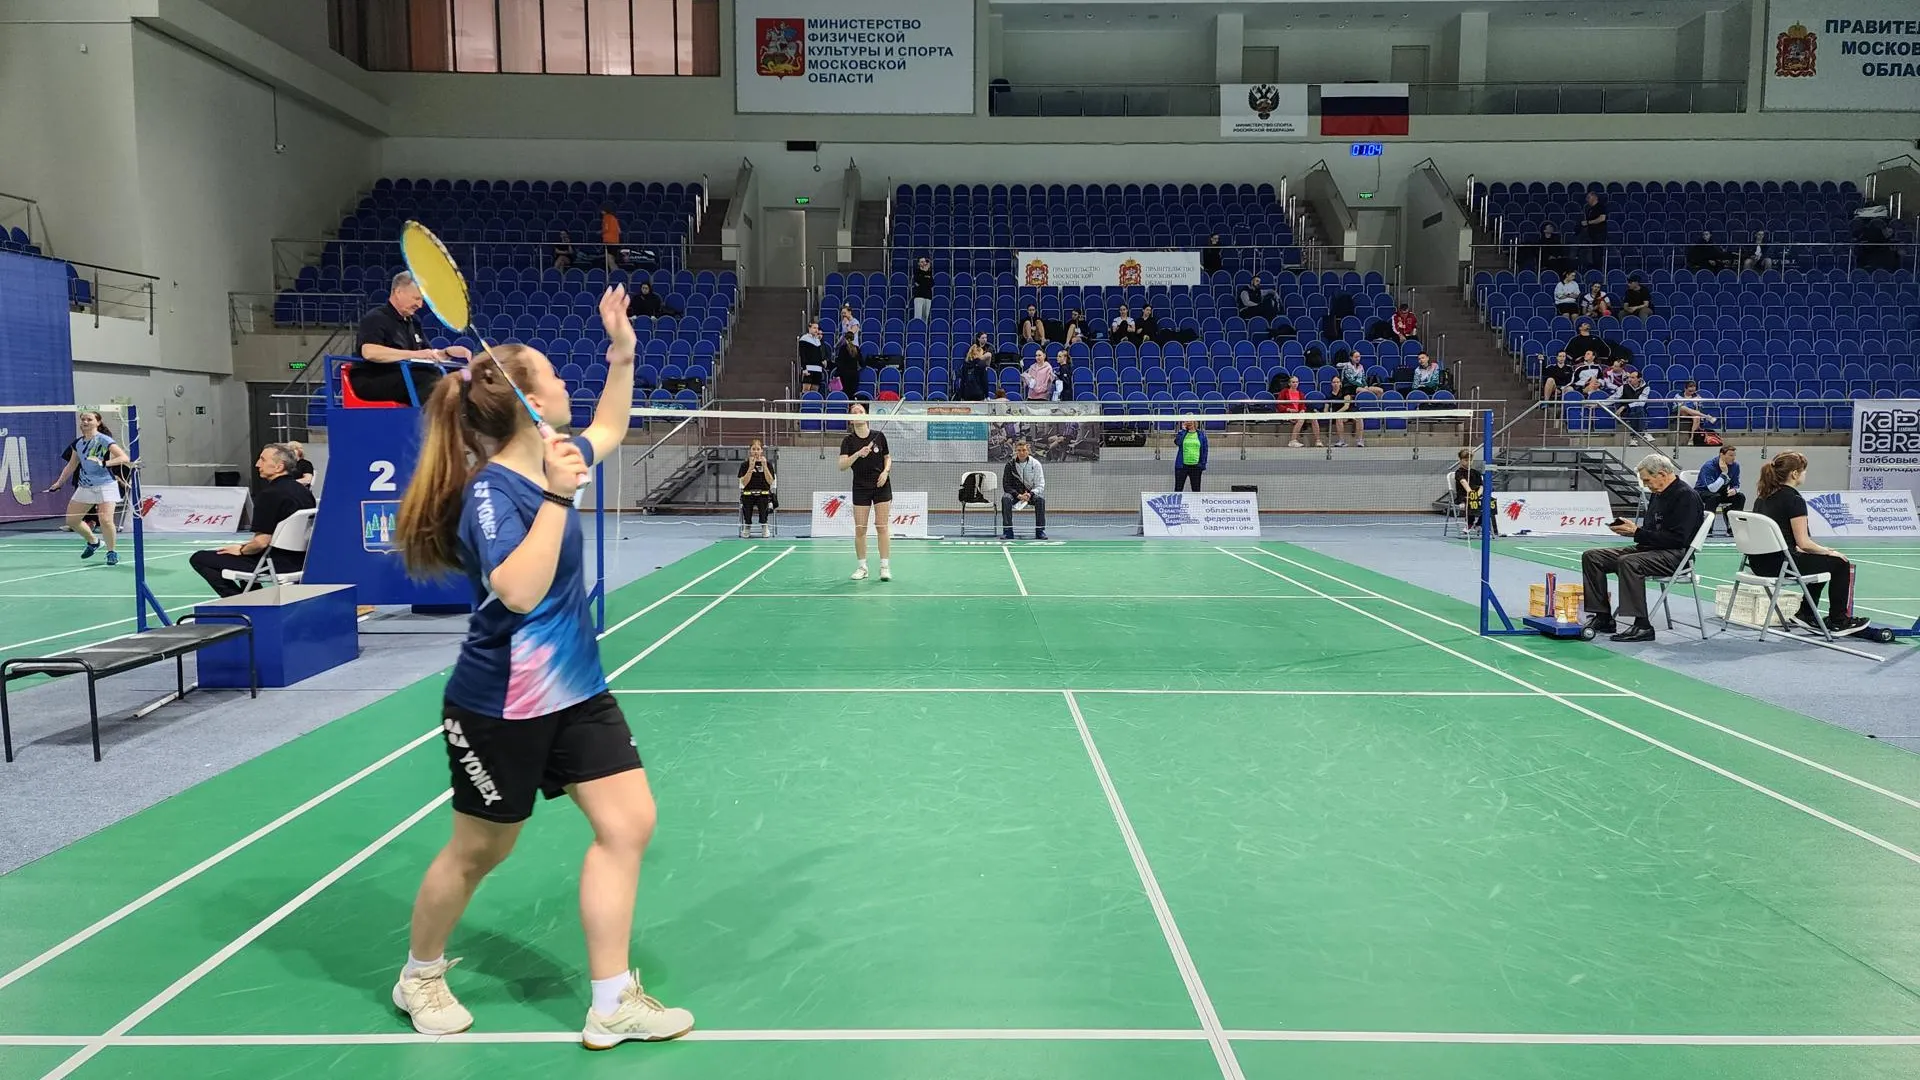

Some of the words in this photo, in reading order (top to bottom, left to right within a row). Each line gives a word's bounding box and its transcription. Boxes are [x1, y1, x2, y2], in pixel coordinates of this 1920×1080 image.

[808, 19, 921, 30] МИНИСТЕРСТВО
[1825, 20, 1920, 35] ПРАВИТЕ
[808, 31, 905, 43] ФИЗИЧЕСКОЙ
[808, 46, 881, 57] КУЛЬТУРЫ
[885, 46, 895, 57] И
[898, 46, 953, 57] СПОРТА
[1842, 41, 1920, 56] МОСКОВ
[808, 58, 906, 70] МОСКОВСКОЙ
[1862, 62, 1920, 77] ОБЛА
[808, 73, 874, 83] ОБЛАСТИ
[1860, 456, 1918, 464] вайбовые
[369, 460, 397, 491] 2
[184, 513, 204, 525] 25
[1560, 516, 1577, 526] 25
[1580, 516, 1606, 526] ЛЕТ
[459, 750, 503, 806] YONEX
